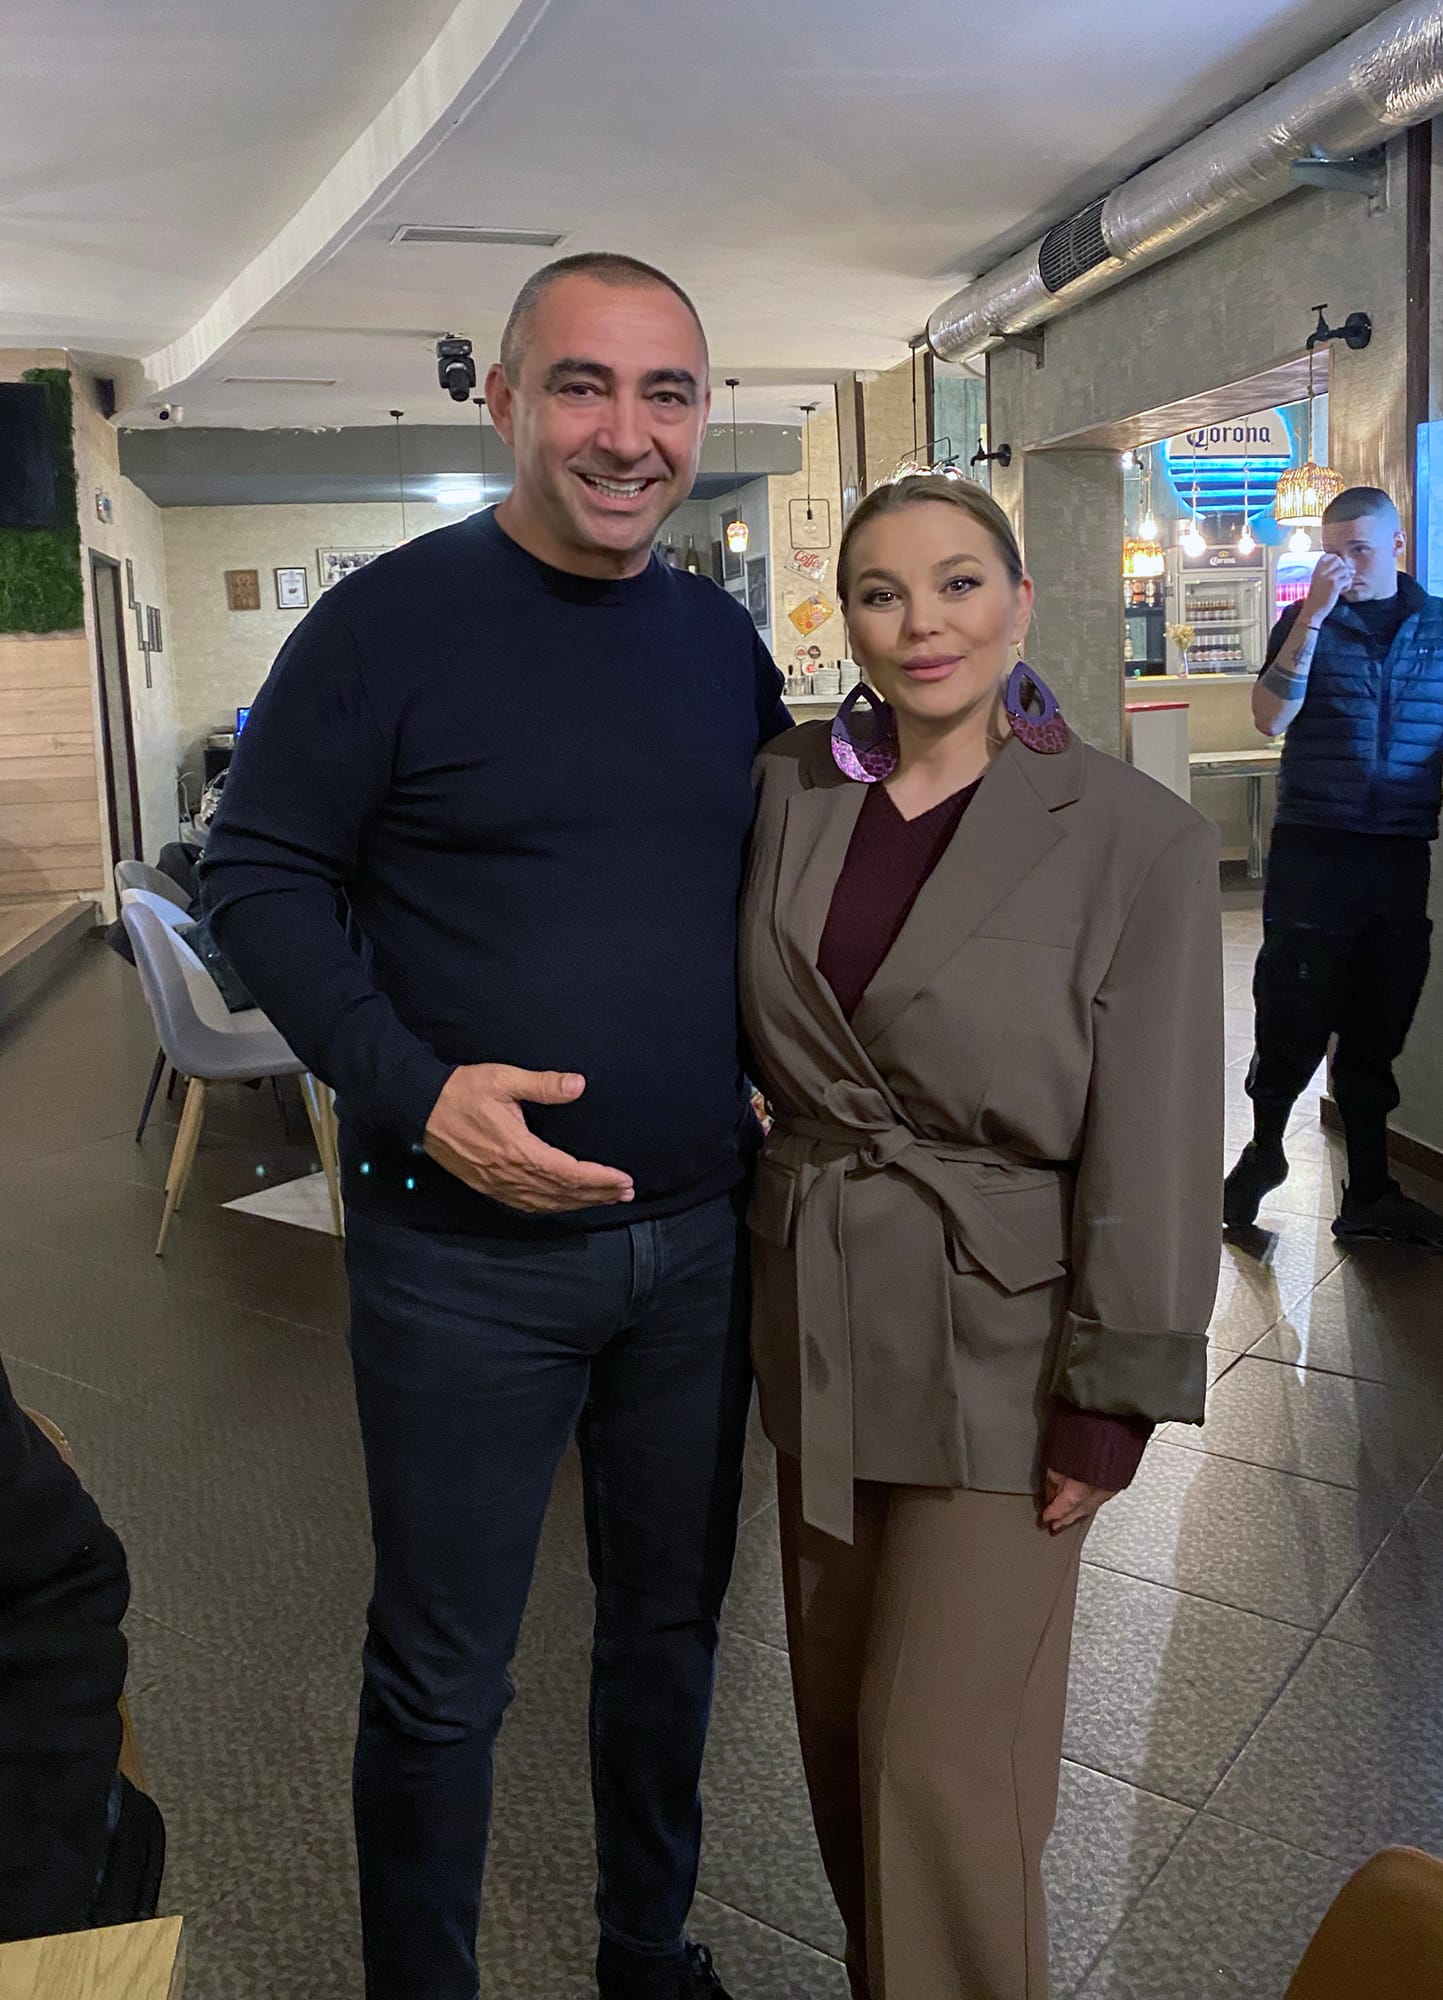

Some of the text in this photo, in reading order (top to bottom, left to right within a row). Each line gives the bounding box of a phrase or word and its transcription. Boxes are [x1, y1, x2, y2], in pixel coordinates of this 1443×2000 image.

[1186, 425, 1271, 450] Corona
[794, 550, 825, 570] Coffee
[1209, 556, 1236, 566] Corona
